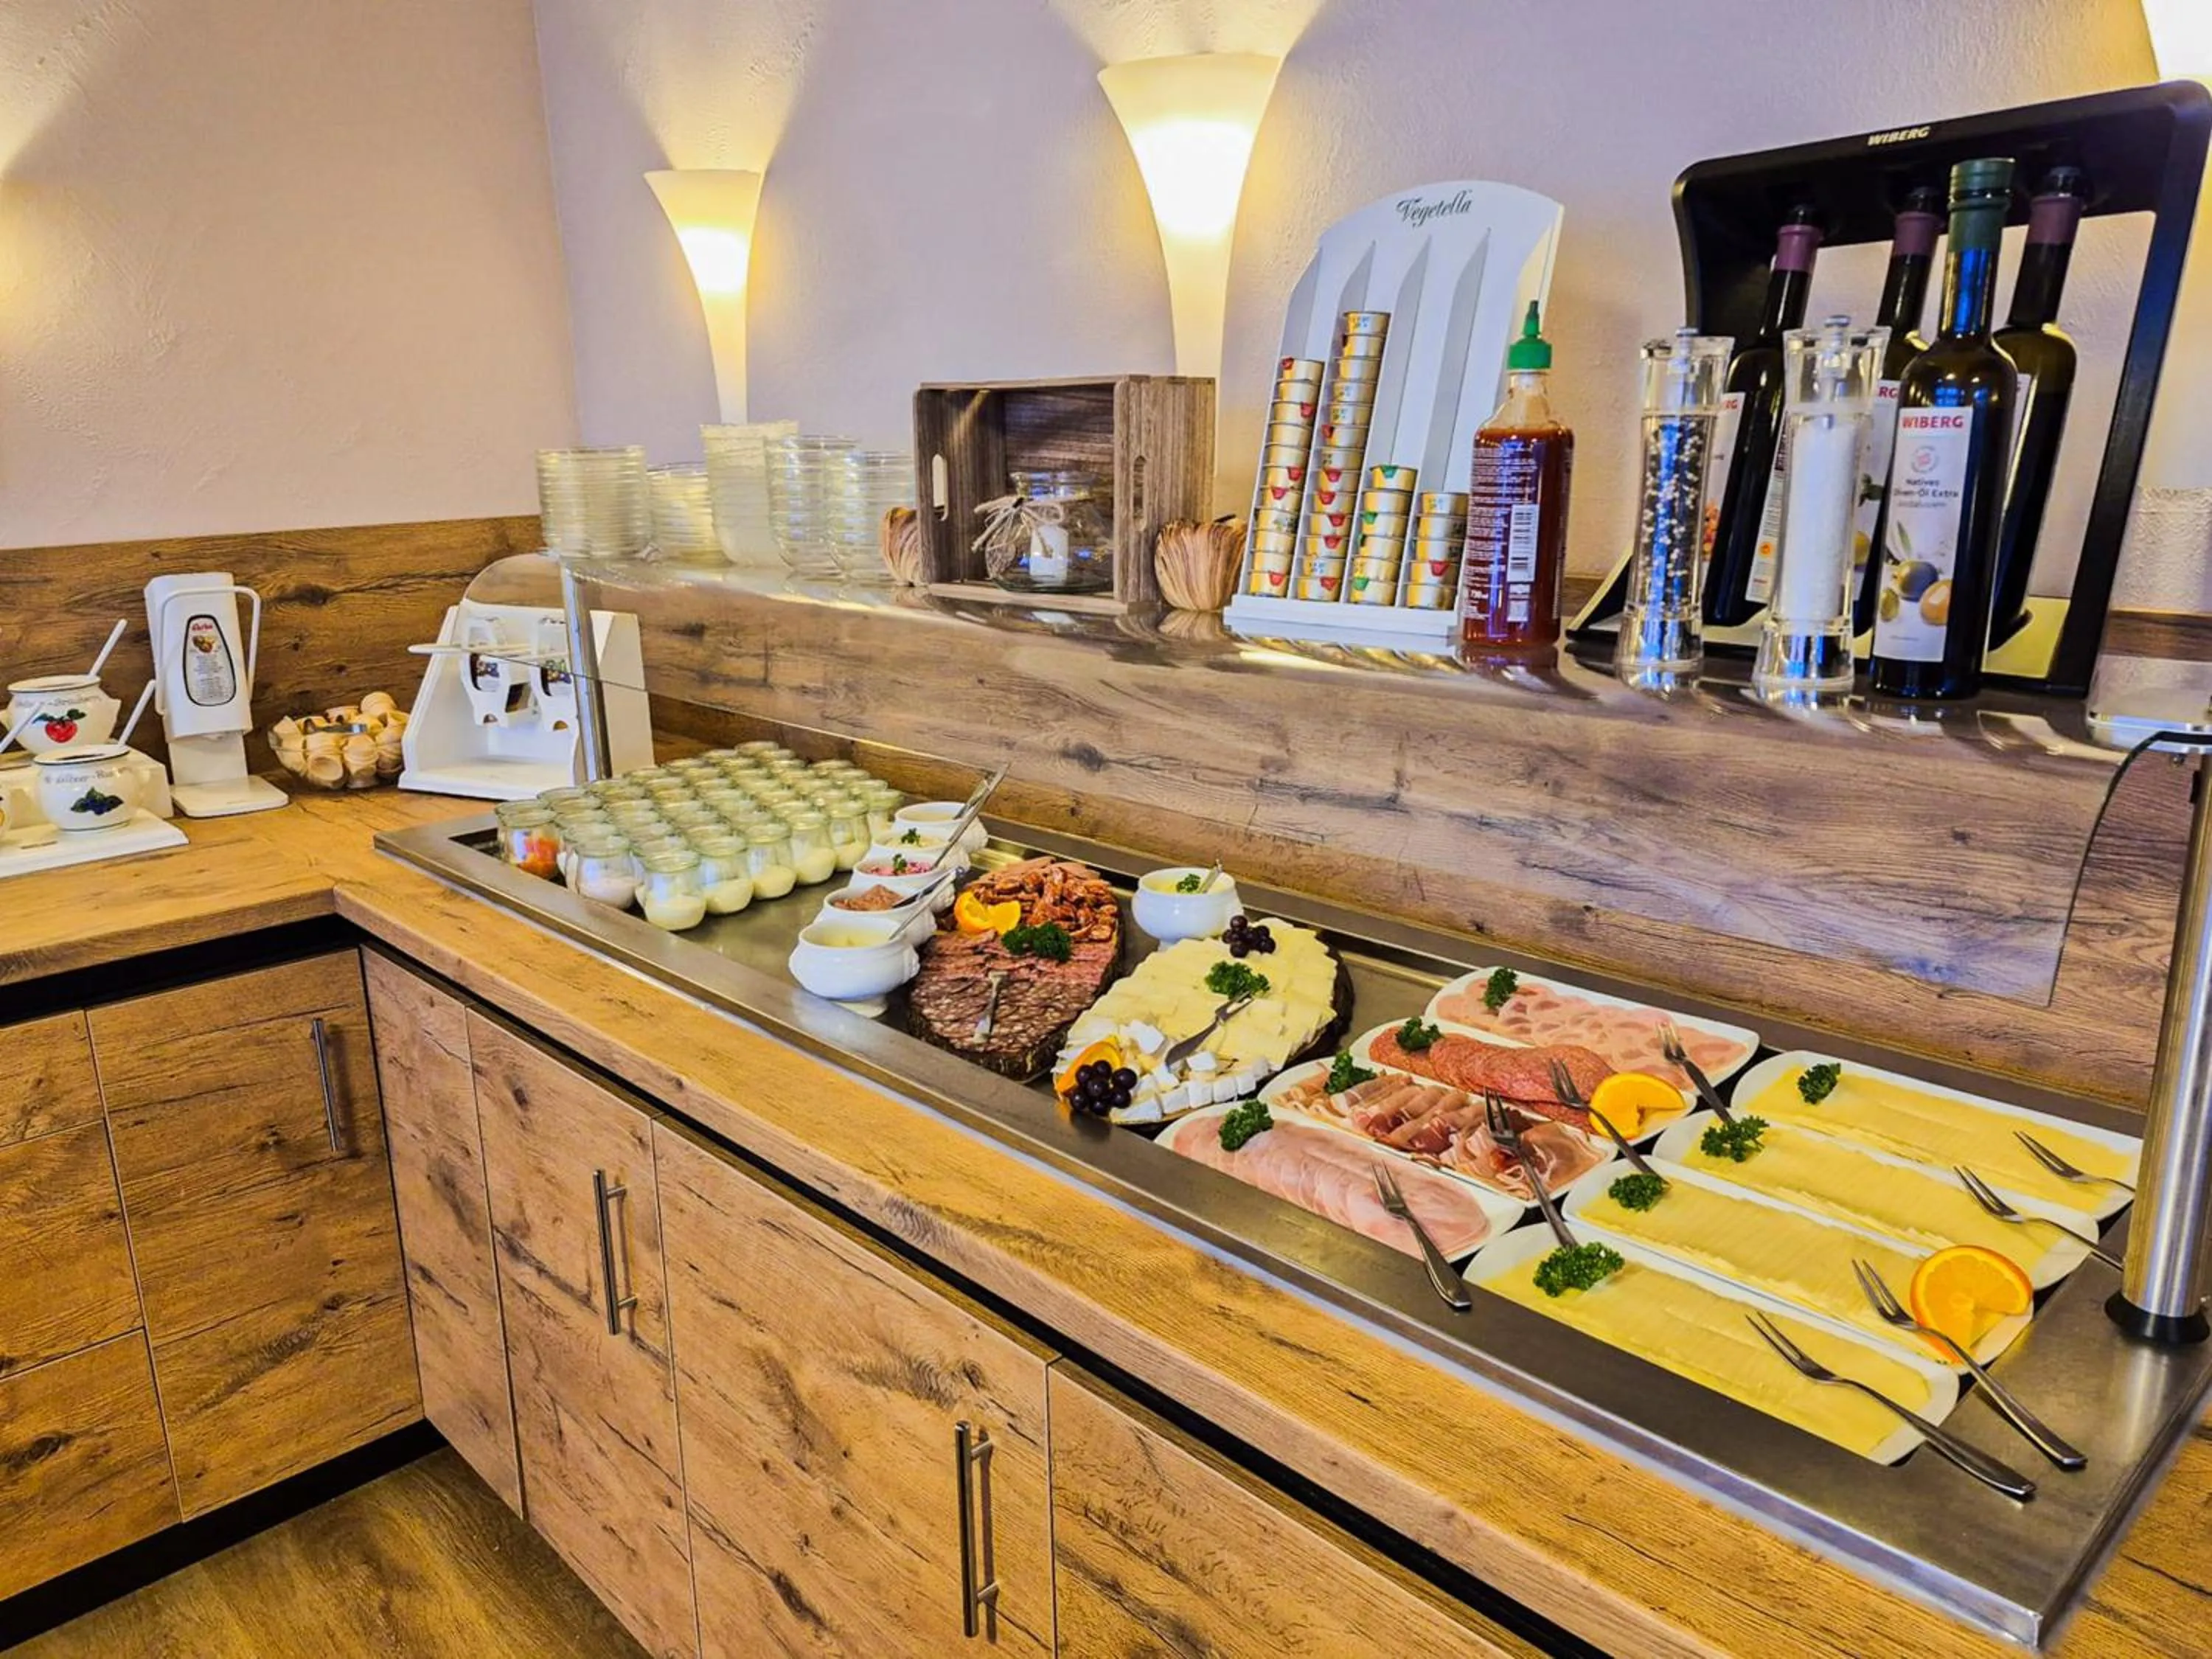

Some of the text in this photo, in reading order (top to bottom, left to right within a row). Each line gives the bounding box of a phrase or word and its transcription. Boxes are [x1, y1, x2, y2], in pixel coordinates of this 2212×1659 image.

[1867, 125, 1932, 146] WIBERG
[1396, 189, 1472, 228] Vegetella
[1902, 415, 1964, 428] WIBERG
